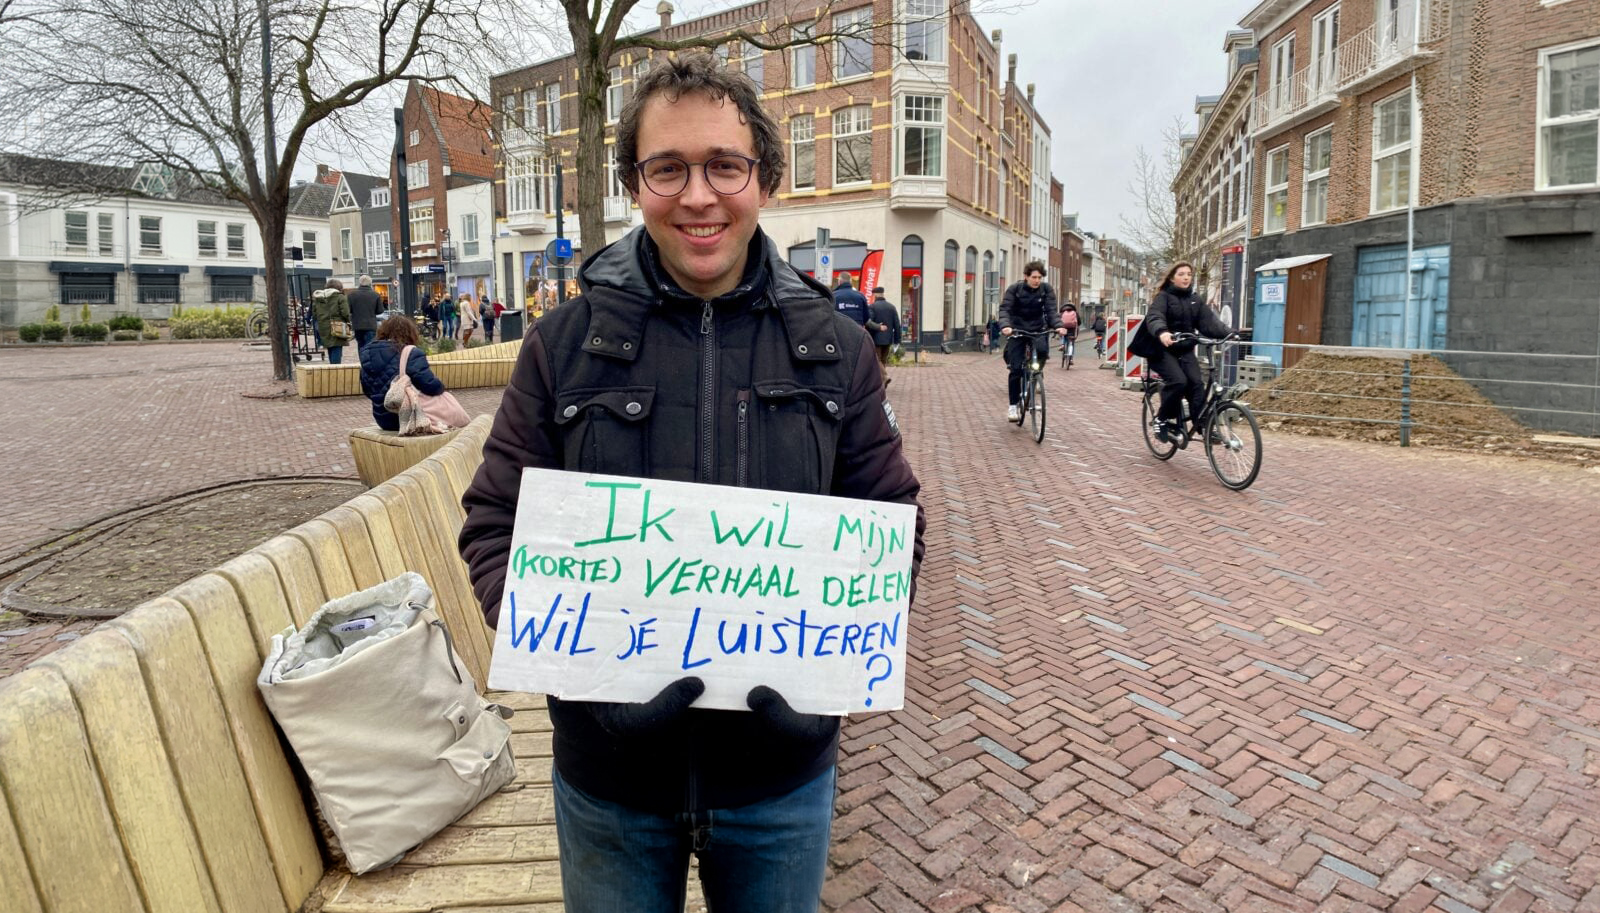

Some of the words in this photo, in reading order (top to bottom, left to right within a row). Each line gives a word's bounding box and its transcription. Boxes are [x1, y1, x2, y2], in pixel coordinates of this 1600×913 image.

[574, 481, 675, 548] Ik
[512, 544, 622, 583] (KORTE)
[644, 557, 800, 599] VERHAAL
[822, 565, 911, 608] DELEN
[865, 654, 893, 707] ?
